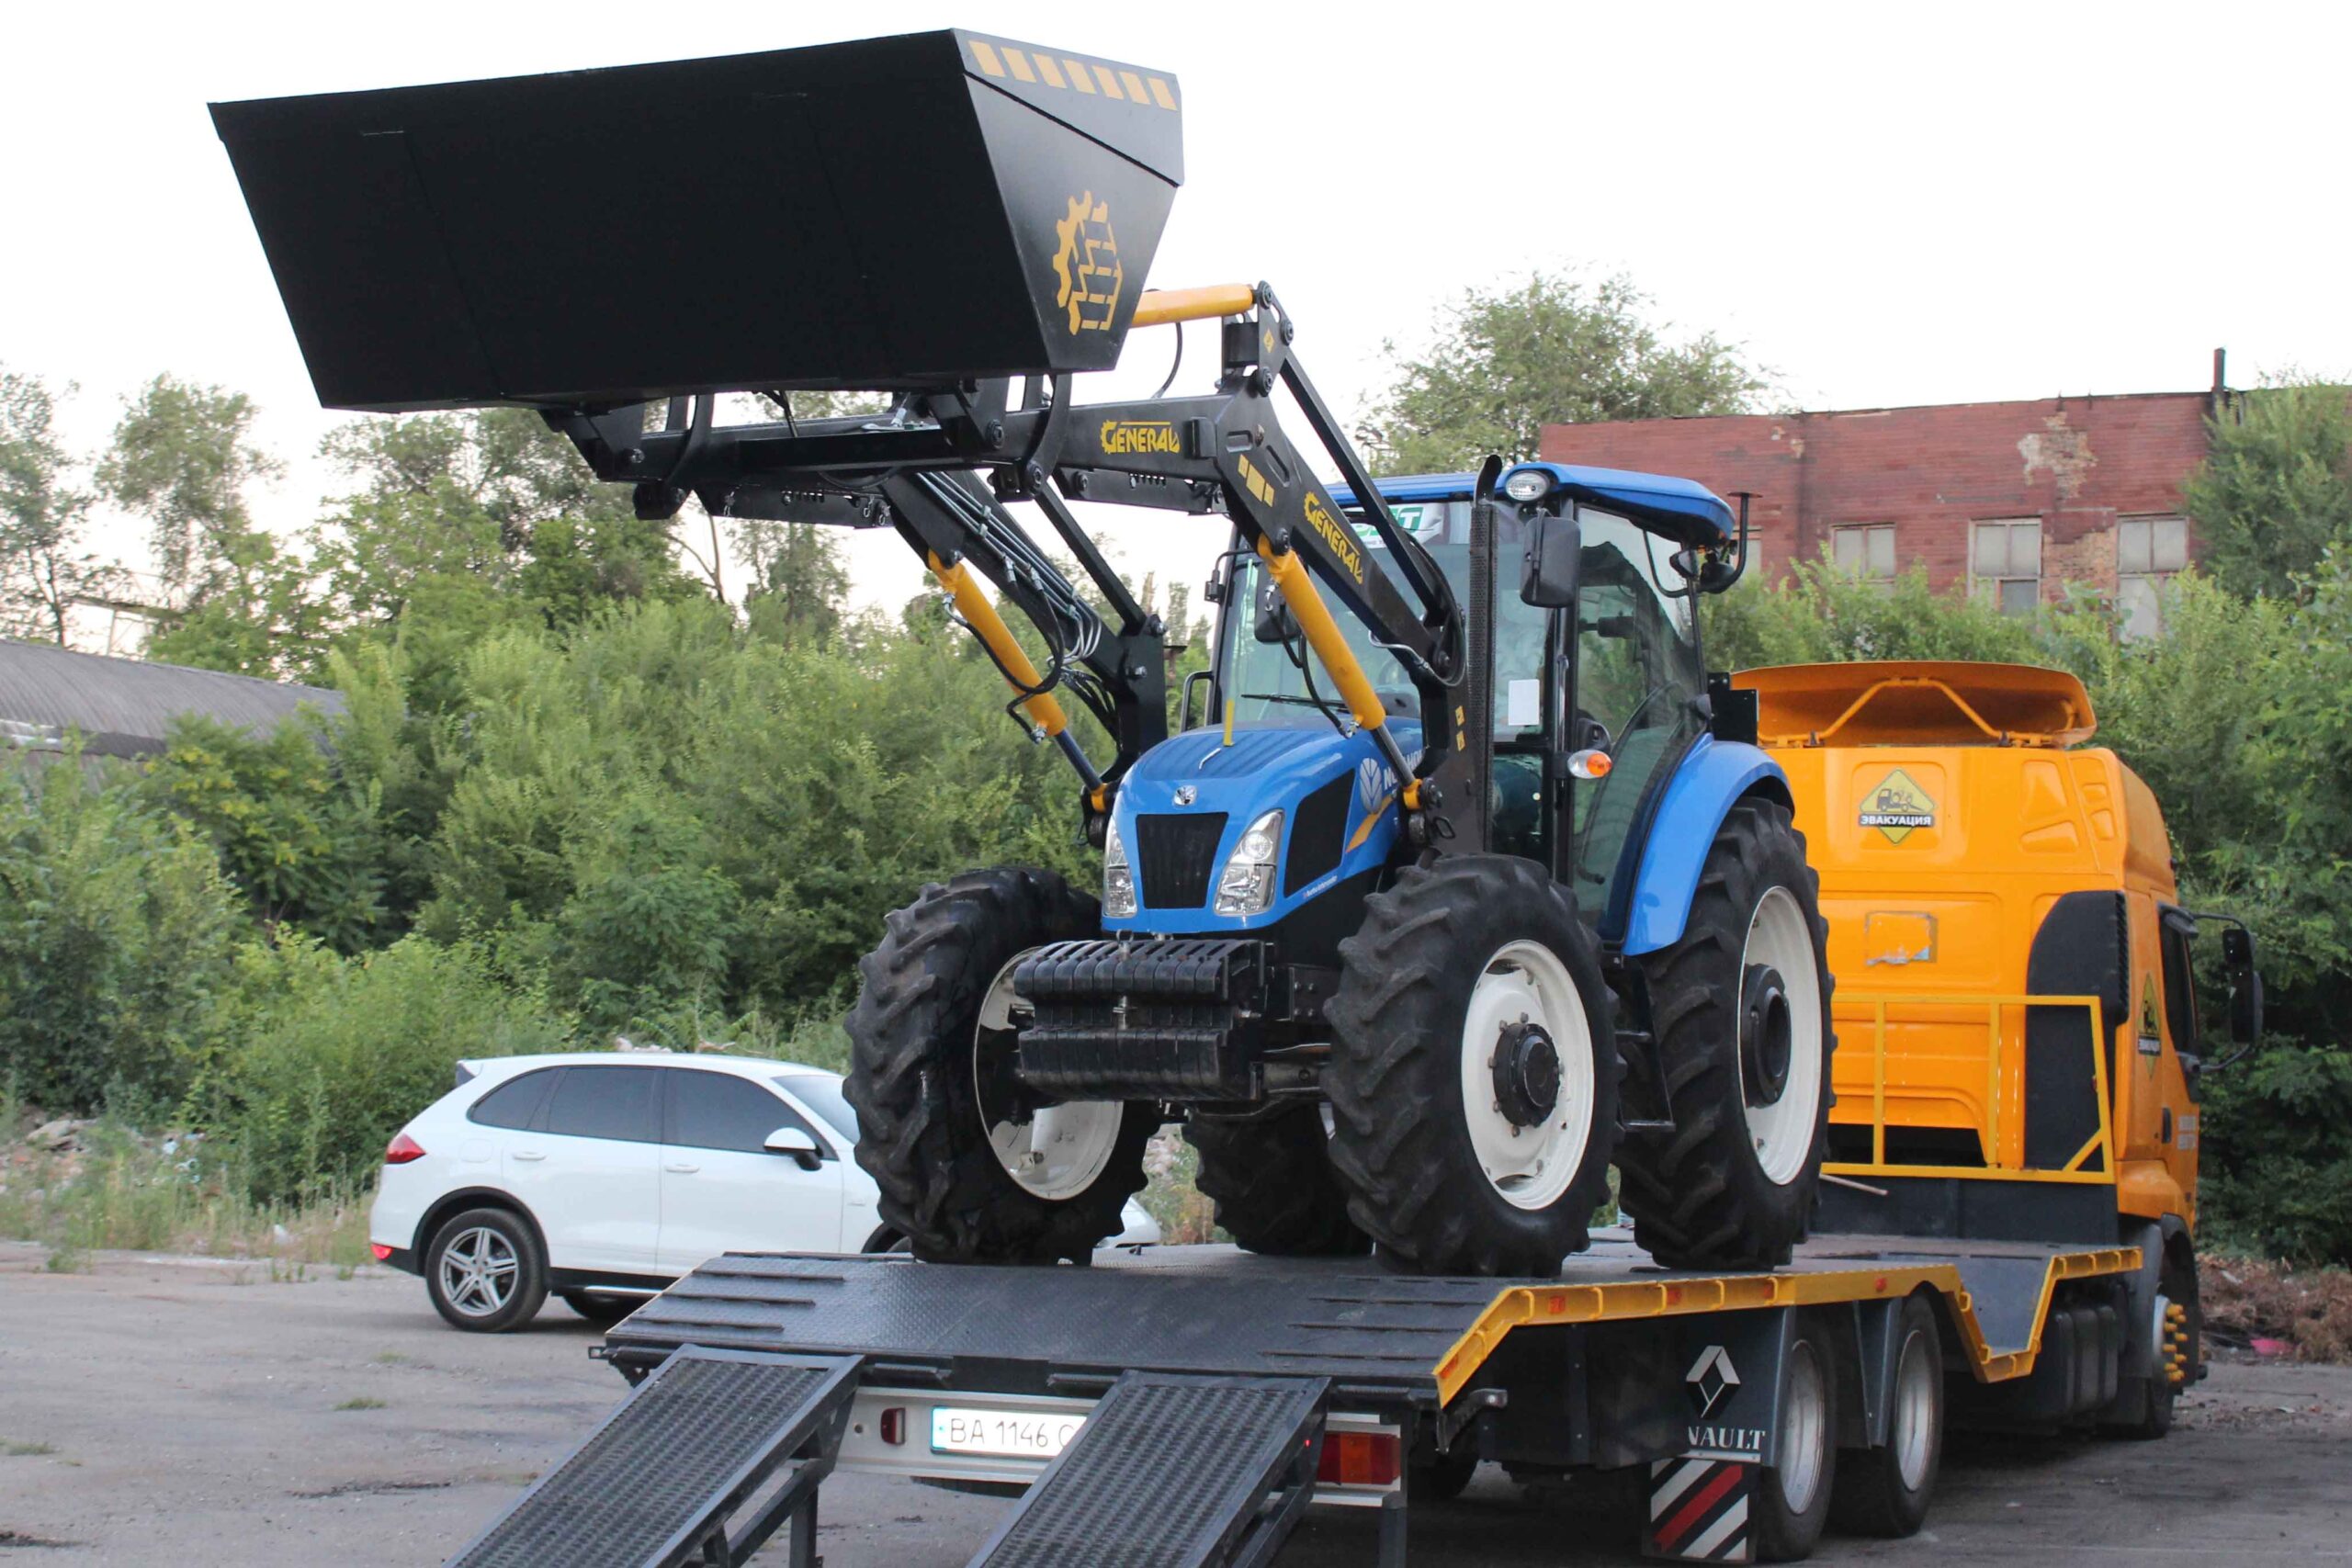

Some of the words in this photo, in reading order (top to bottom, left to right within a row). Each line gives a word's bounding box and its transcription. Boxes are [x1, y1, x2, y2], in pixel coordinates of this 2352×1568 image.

[1100, 420, 1181, 454] GENERAL
[1303, 491, 1363, 585] GENERAL
[1860, 815, 1931, 826] ЭВАКУАЦИЯ
[995, 1420, 1048, 1449] 1146
